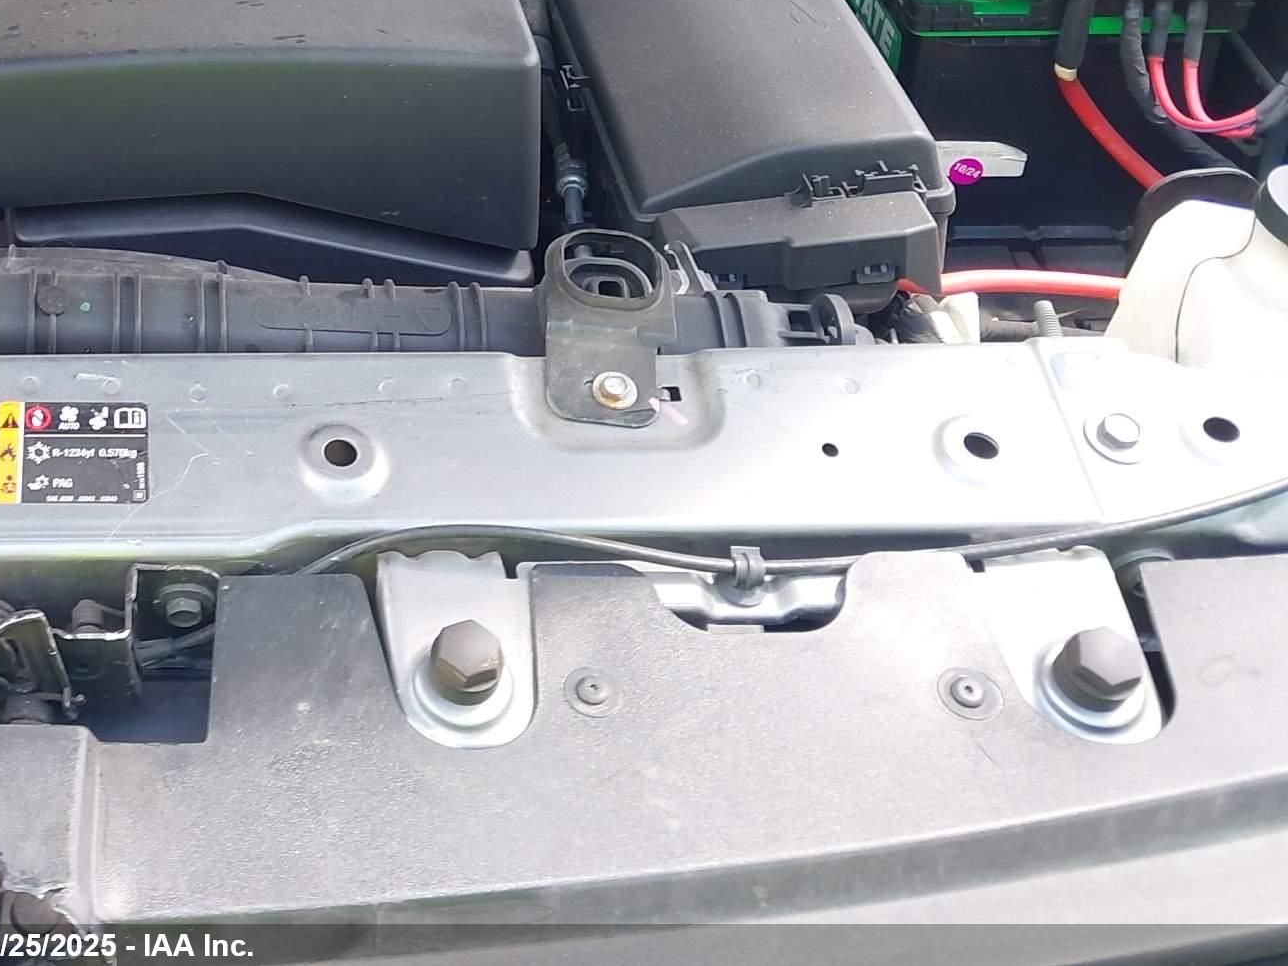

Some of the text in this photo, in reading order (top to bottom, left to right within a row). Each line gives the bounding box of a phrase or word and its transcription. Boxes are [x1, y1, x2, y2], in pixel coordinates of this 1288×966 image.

[953, 162, 981, 179] 10/24
[58, 422, 81, 431] AUTO
[52, 478, 74, 489] PAG
